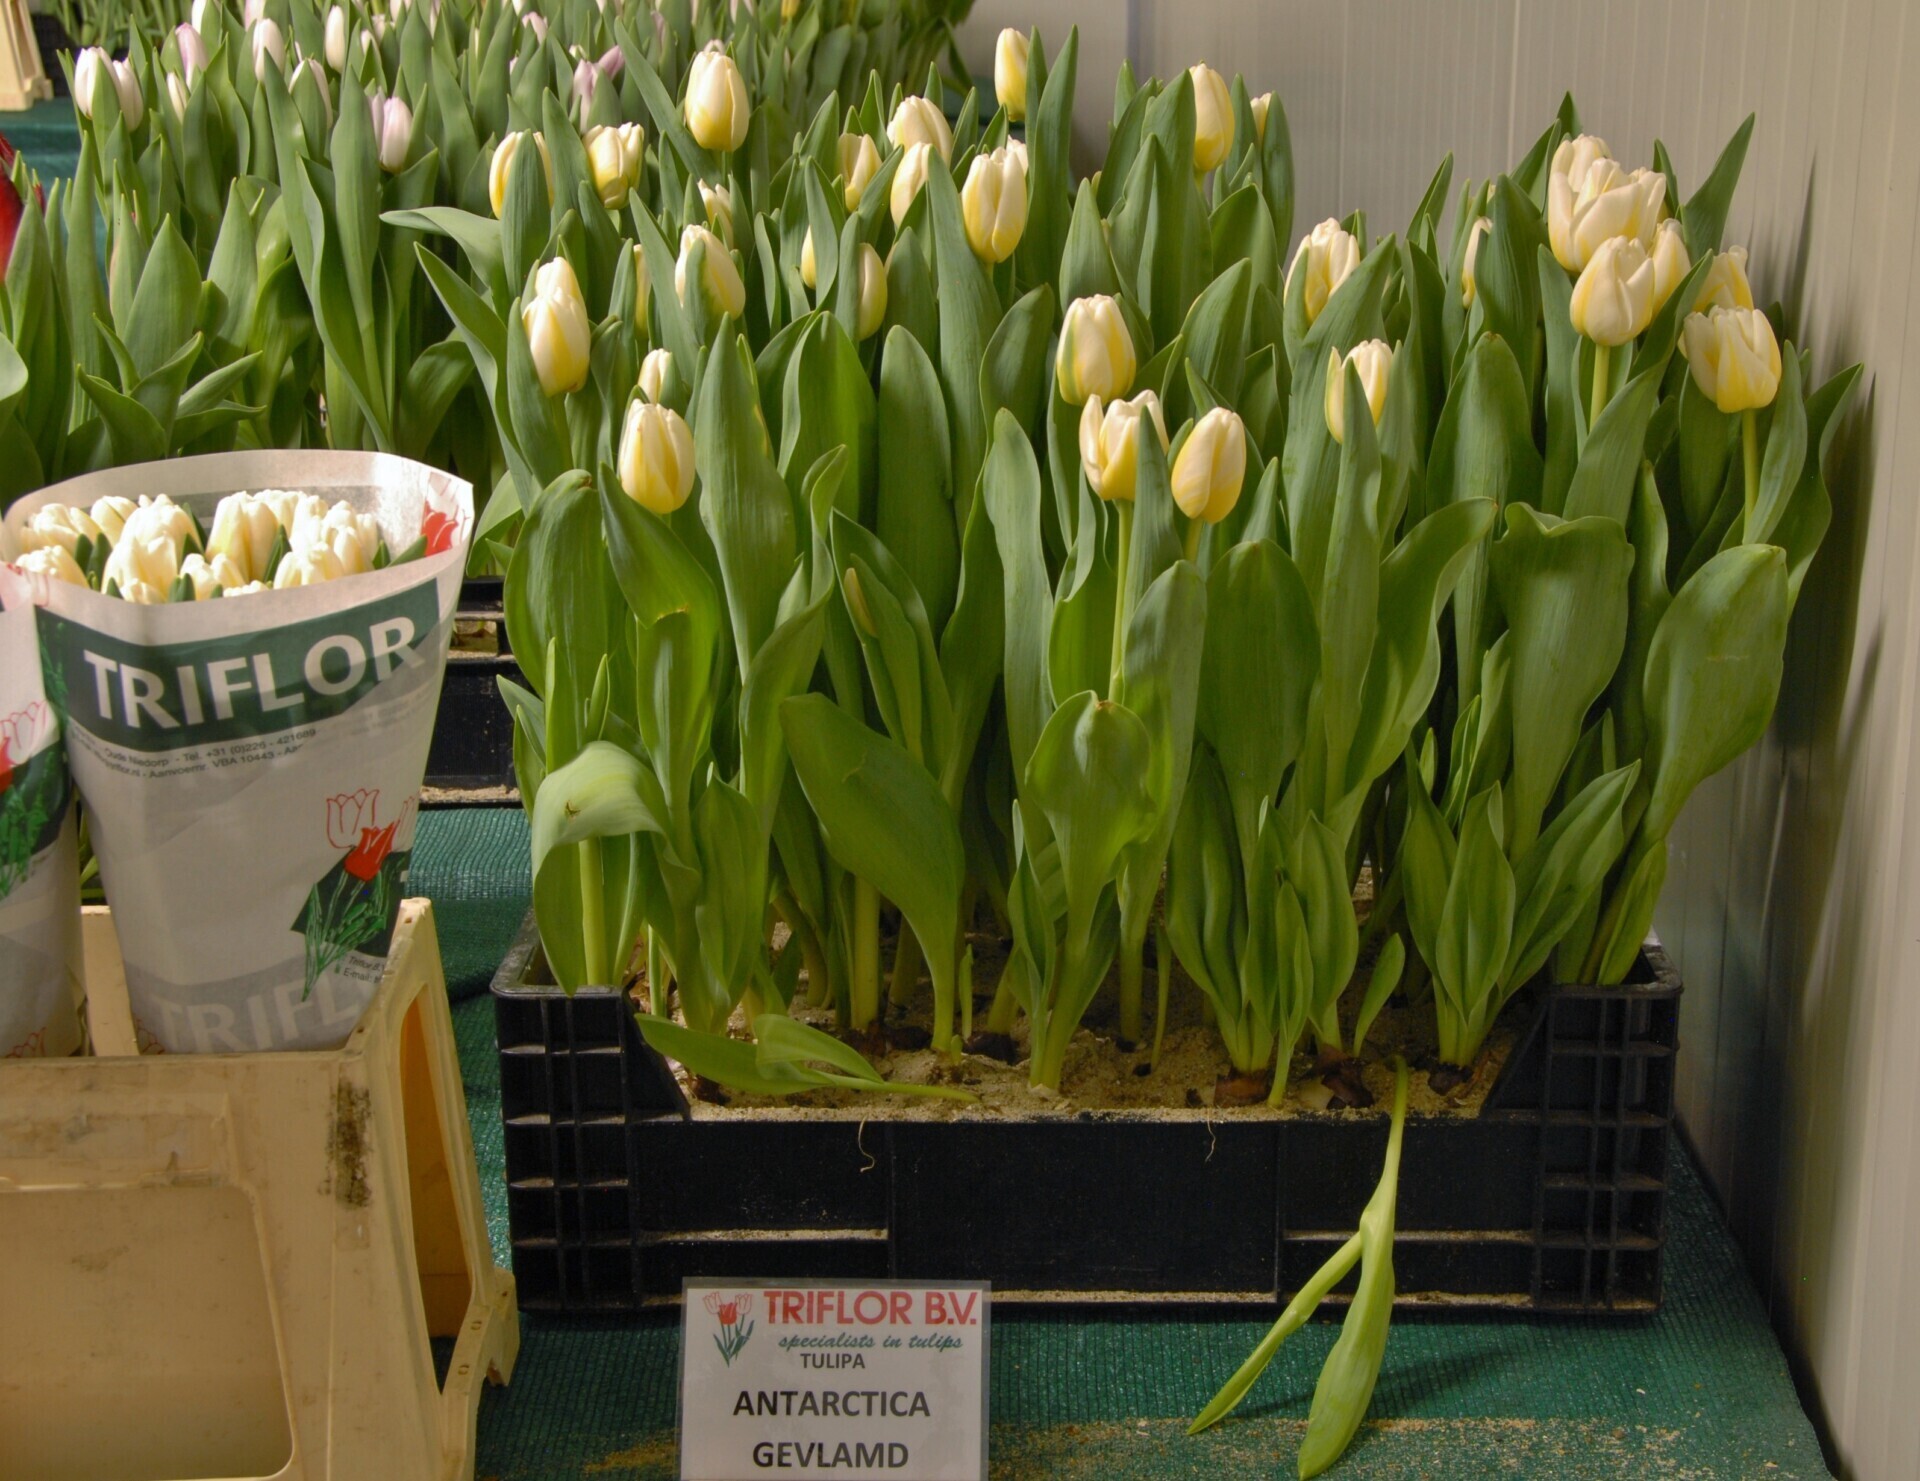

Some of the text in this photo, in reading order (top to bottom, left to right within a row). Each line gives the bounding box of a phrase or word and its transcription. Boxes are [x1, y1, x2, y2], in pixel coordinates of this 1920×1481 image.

[84, 616, 425, 730] TRIFLOR
[206, 748, 227, 757] +31
[212, 757, 237, 768] VBA
[239, 750, 275, 763] 10443
[763, 1290, 977, 1325] TRIFLOR B.V.
[778, 1333, 963, 1352] specialists in tulips
[800, 1353, 866, 1369] TULIPA
[732, 1390, 931, 1417] ANTARCTICA
[752, 1441, 909, 1469] GEVLAMD
